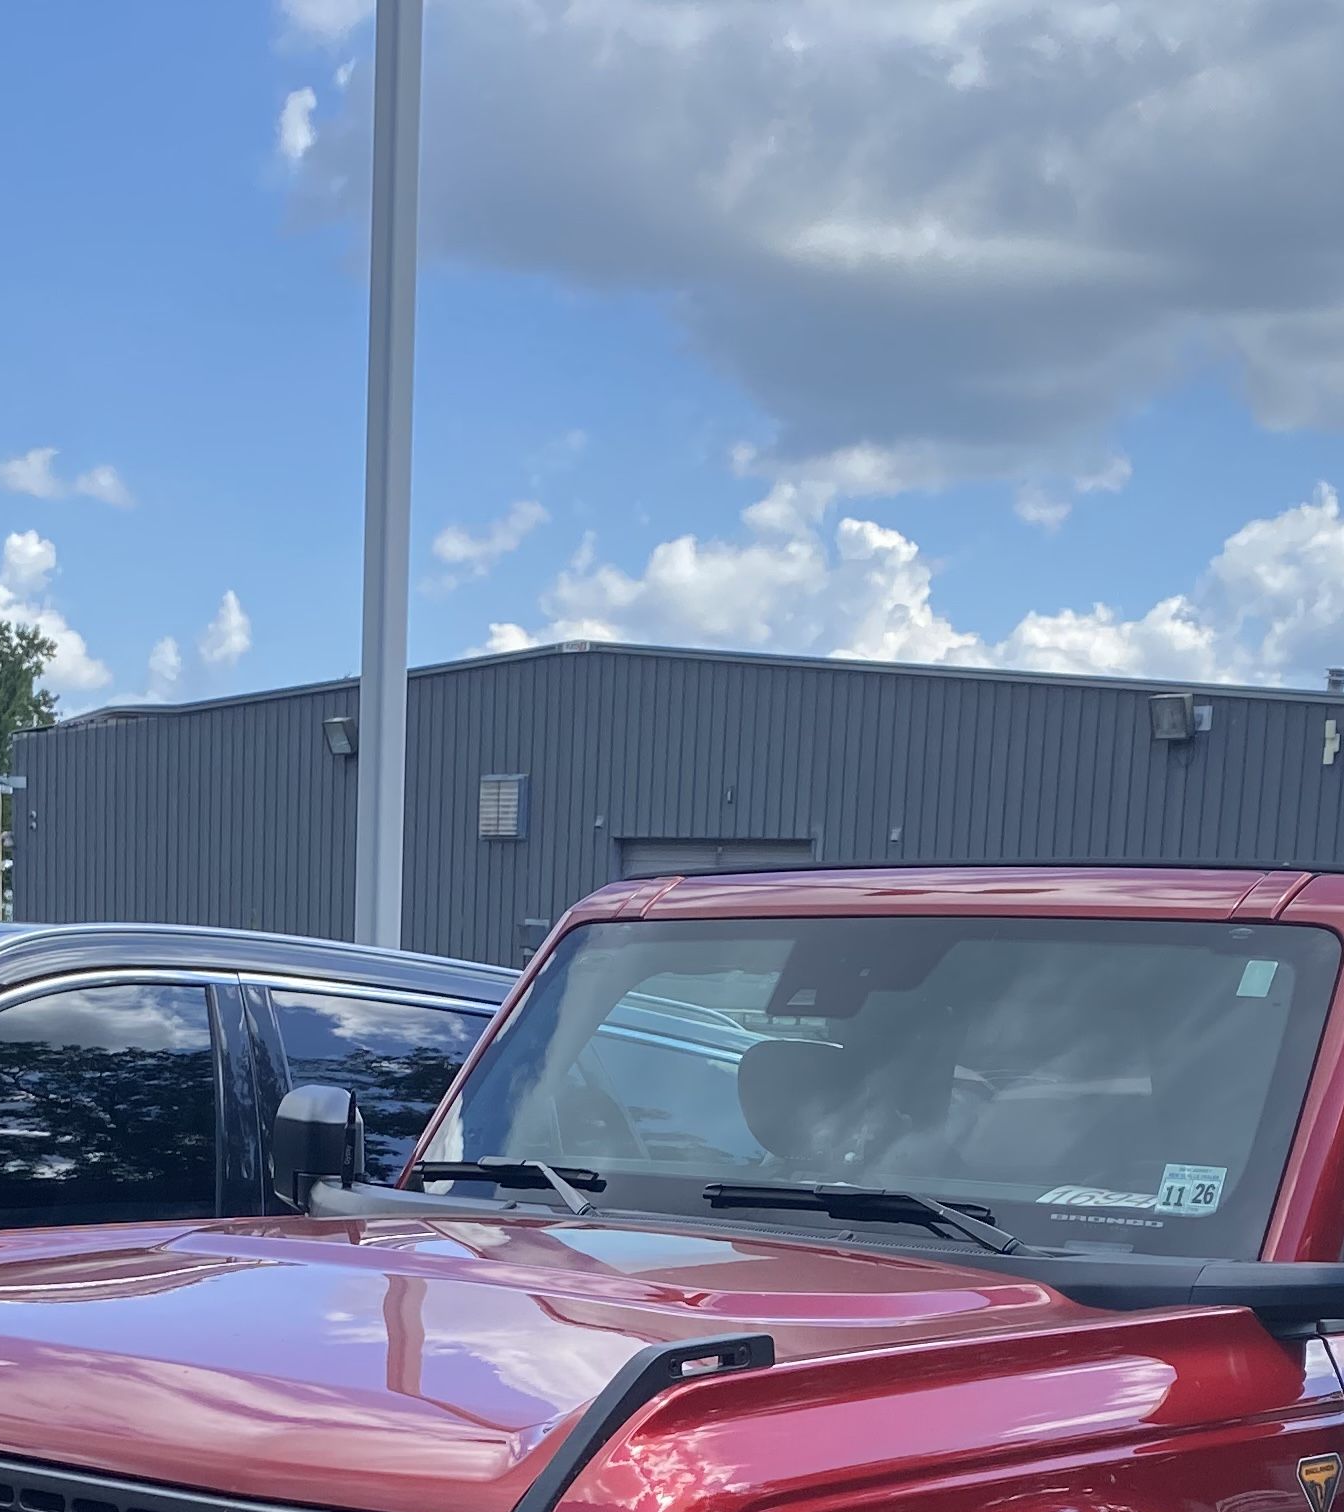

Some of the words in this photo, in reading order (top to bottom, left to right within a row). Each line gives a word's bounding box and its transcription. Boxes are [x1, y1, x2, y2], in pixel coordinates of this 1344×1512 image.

[1162, 1185, 1186, 1207] 11
[1191, 1183, 1216, 1205] 26
[1050, 1213, 1164, 1227] BRONCO
